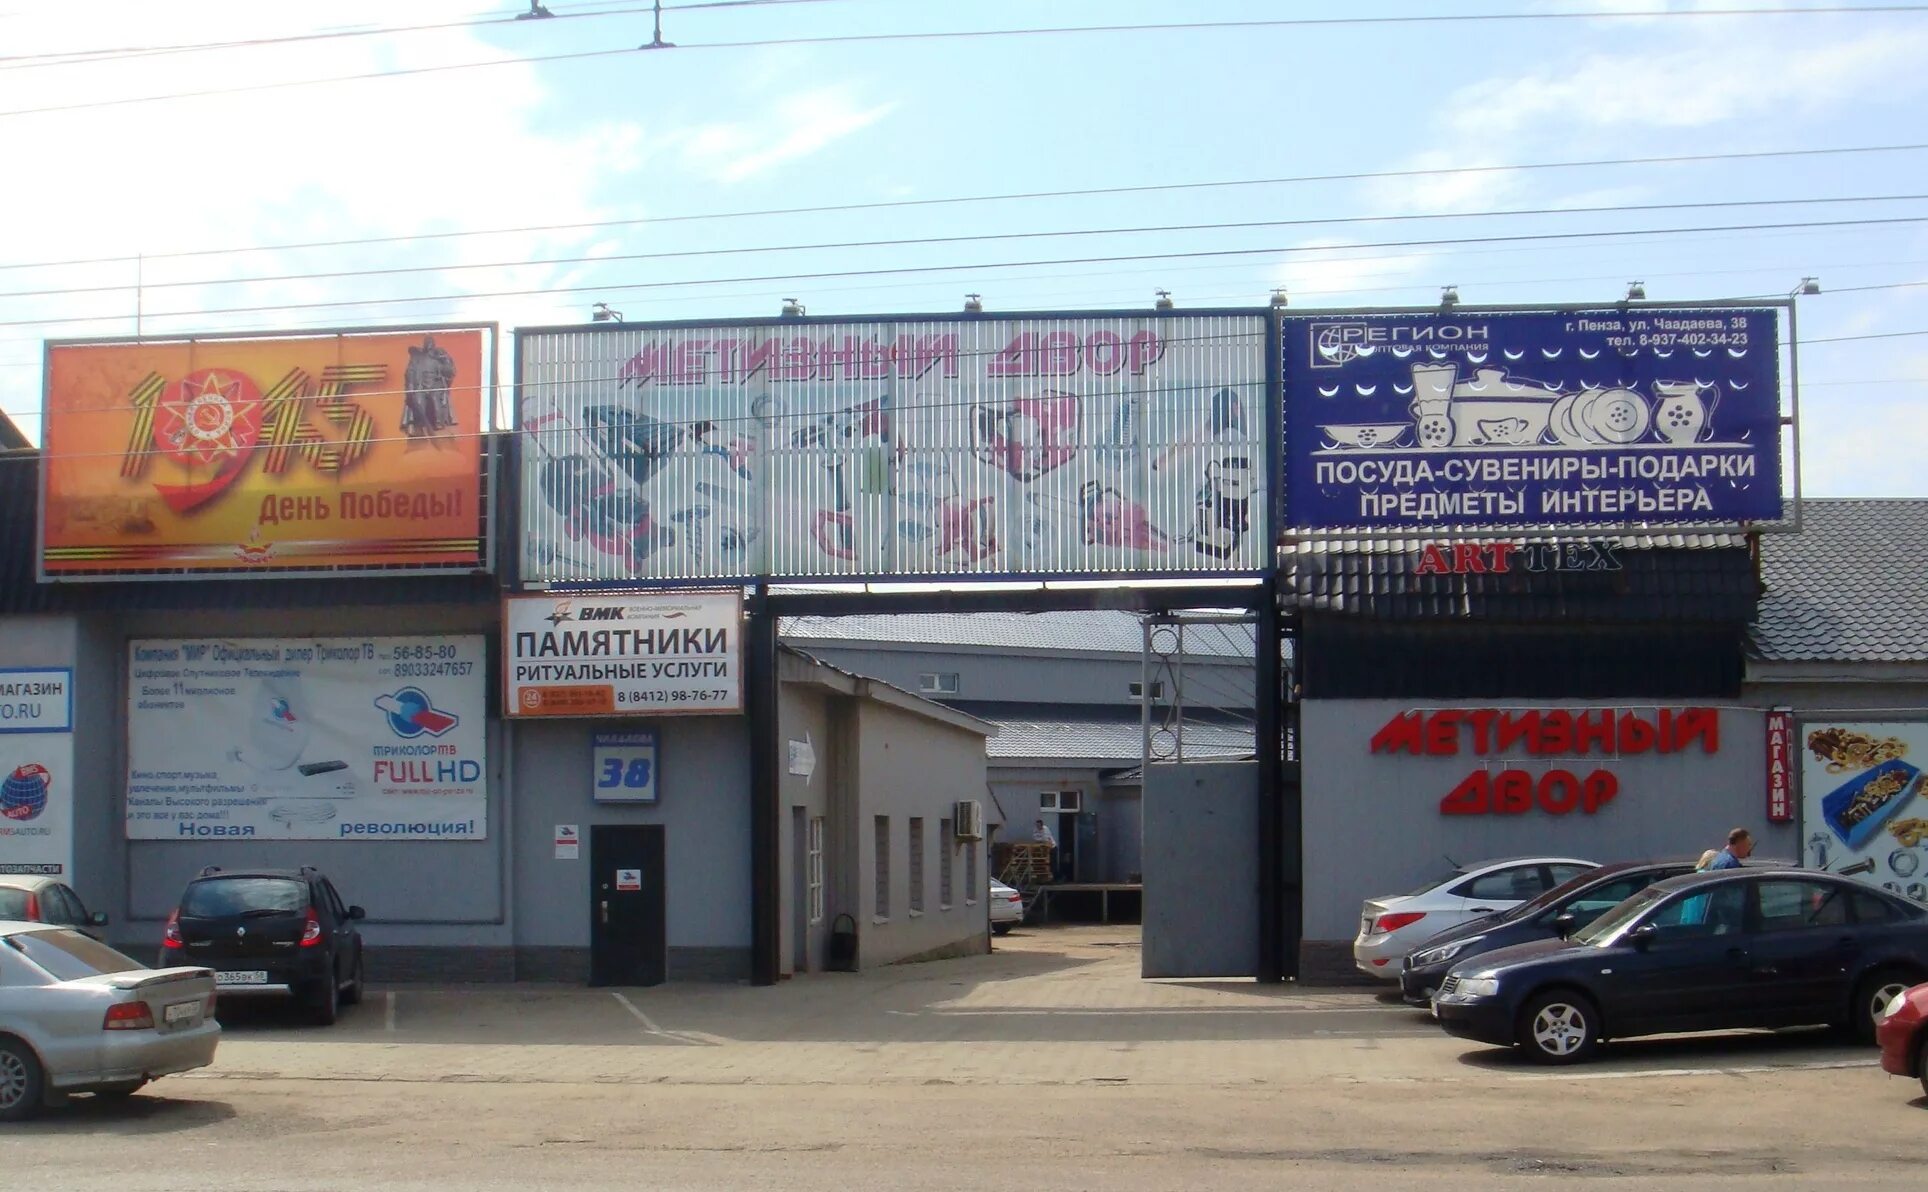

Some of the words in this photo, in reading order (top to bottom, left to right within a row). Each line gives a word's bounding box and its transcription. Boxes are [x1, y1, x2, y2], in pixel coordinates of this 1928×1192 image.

[1343, 325, 1488, 342] РЕГИОН
[1565, 322, 1575, 332] г.
[1578, 319, 1626, 332] Пенза,
[1628, 319, 1650, 331] ул.
[1653, 317, 1727, 331] Чаадаева,
[1731, 317, 1748, 329] 38
[1606, 337, 1636, 347] тел.
[1639, 333, 1748, 346] 8-937-402-34-23
[987, 329, 1165, 377] ДВОР
[120, 363, 390, 514] 1945
[1316, 455, 1756, 486] ПОСУДА-СУВЕНИРЫ-ПОДАРКИ
[258, 493, 331, 526] День
[339, 488, 463, 521] Победы!
[1360, 491, 1525, 519] ПРЕДМЕТЫ
[1541, 489, 1713, 513] ИНТЕРЬЕРА
[1414, 543, 1516, 575] ART
[1522, 540, 1624, 571] TEX
[578, 607, 624, 621] ВМК
[516, 628, 728, 658] ПАМЯТНИКИ
[212, 644, 280, 663] Официальный
[316, 644, 360, 663] Триколор
[362, 644, 374, 659] ТВ
[393, 645, 457, 660] 56-85-80
[183, 668, 241, 679] Спутниковое
[394, 662, 473, 677] 89033247657
[516, 663, 647, 681] РИТУАЛЬНЫЕ
[652, 662, 728, 679] УСЛУГИ
[142, 686, 170, 696] Более
[173, 682, 184, 696] 11
[617, 692, 626, 703] 8
[629, 691, 669, 704] (8412)
[671, 689, 729, 702] 98-76-77
[0, 703, 41, 719] O.RU
[437, 760, 480, 783] HD
[598, 758, 651, 788] 38
[1769, 716, 1785, 817] МАГАЗИН
[1440, 769, 1619, 814] ДВОР
[165, 796, 210, 807] Высокого
[179, 822, 255, 836] Новая
[340, 820, 475, 837] революция!
